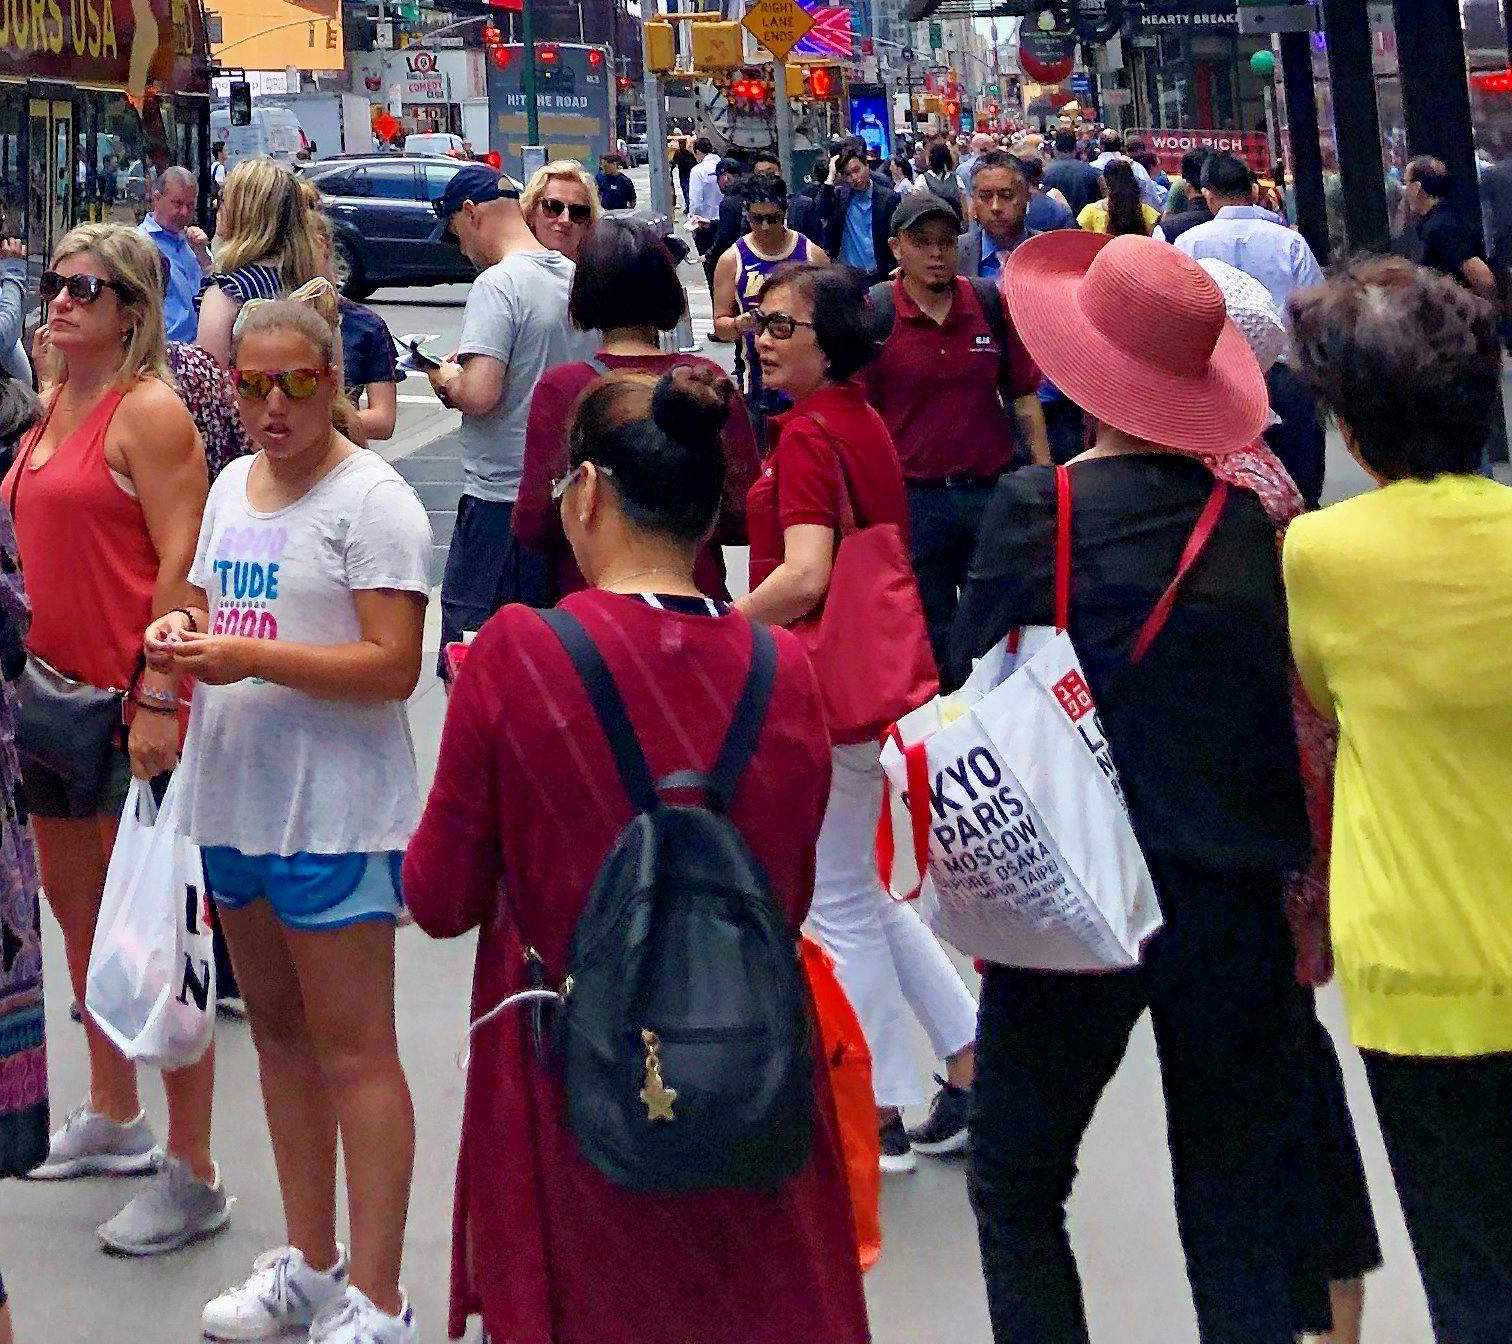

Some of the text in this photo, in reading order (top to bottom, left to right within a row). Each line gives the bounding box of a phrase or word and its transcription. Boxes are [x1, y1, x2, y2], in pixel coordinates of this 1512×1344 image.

[760, 2, 794, 13] RIGHT
[762, 16, 794, 28] LANE
[1141, 13, 1239, 25] HEARTY BREAK
[763, 31, 794, 42] ENDS
[408, 81, 443, 93] COMEDY
[508, 94, 588, 108] HIT HE ROAD
[212, 559, 280, 600] 'TUDE
[930, 746, 1003, 820] KYO
[934, 785, 1024, 855] PARIS
[943, 814, 1039, 877] MOSCOW
[996, 841, 1051, 881] OSAKA
[1020, 859, 1060, 888] TAIPEI
